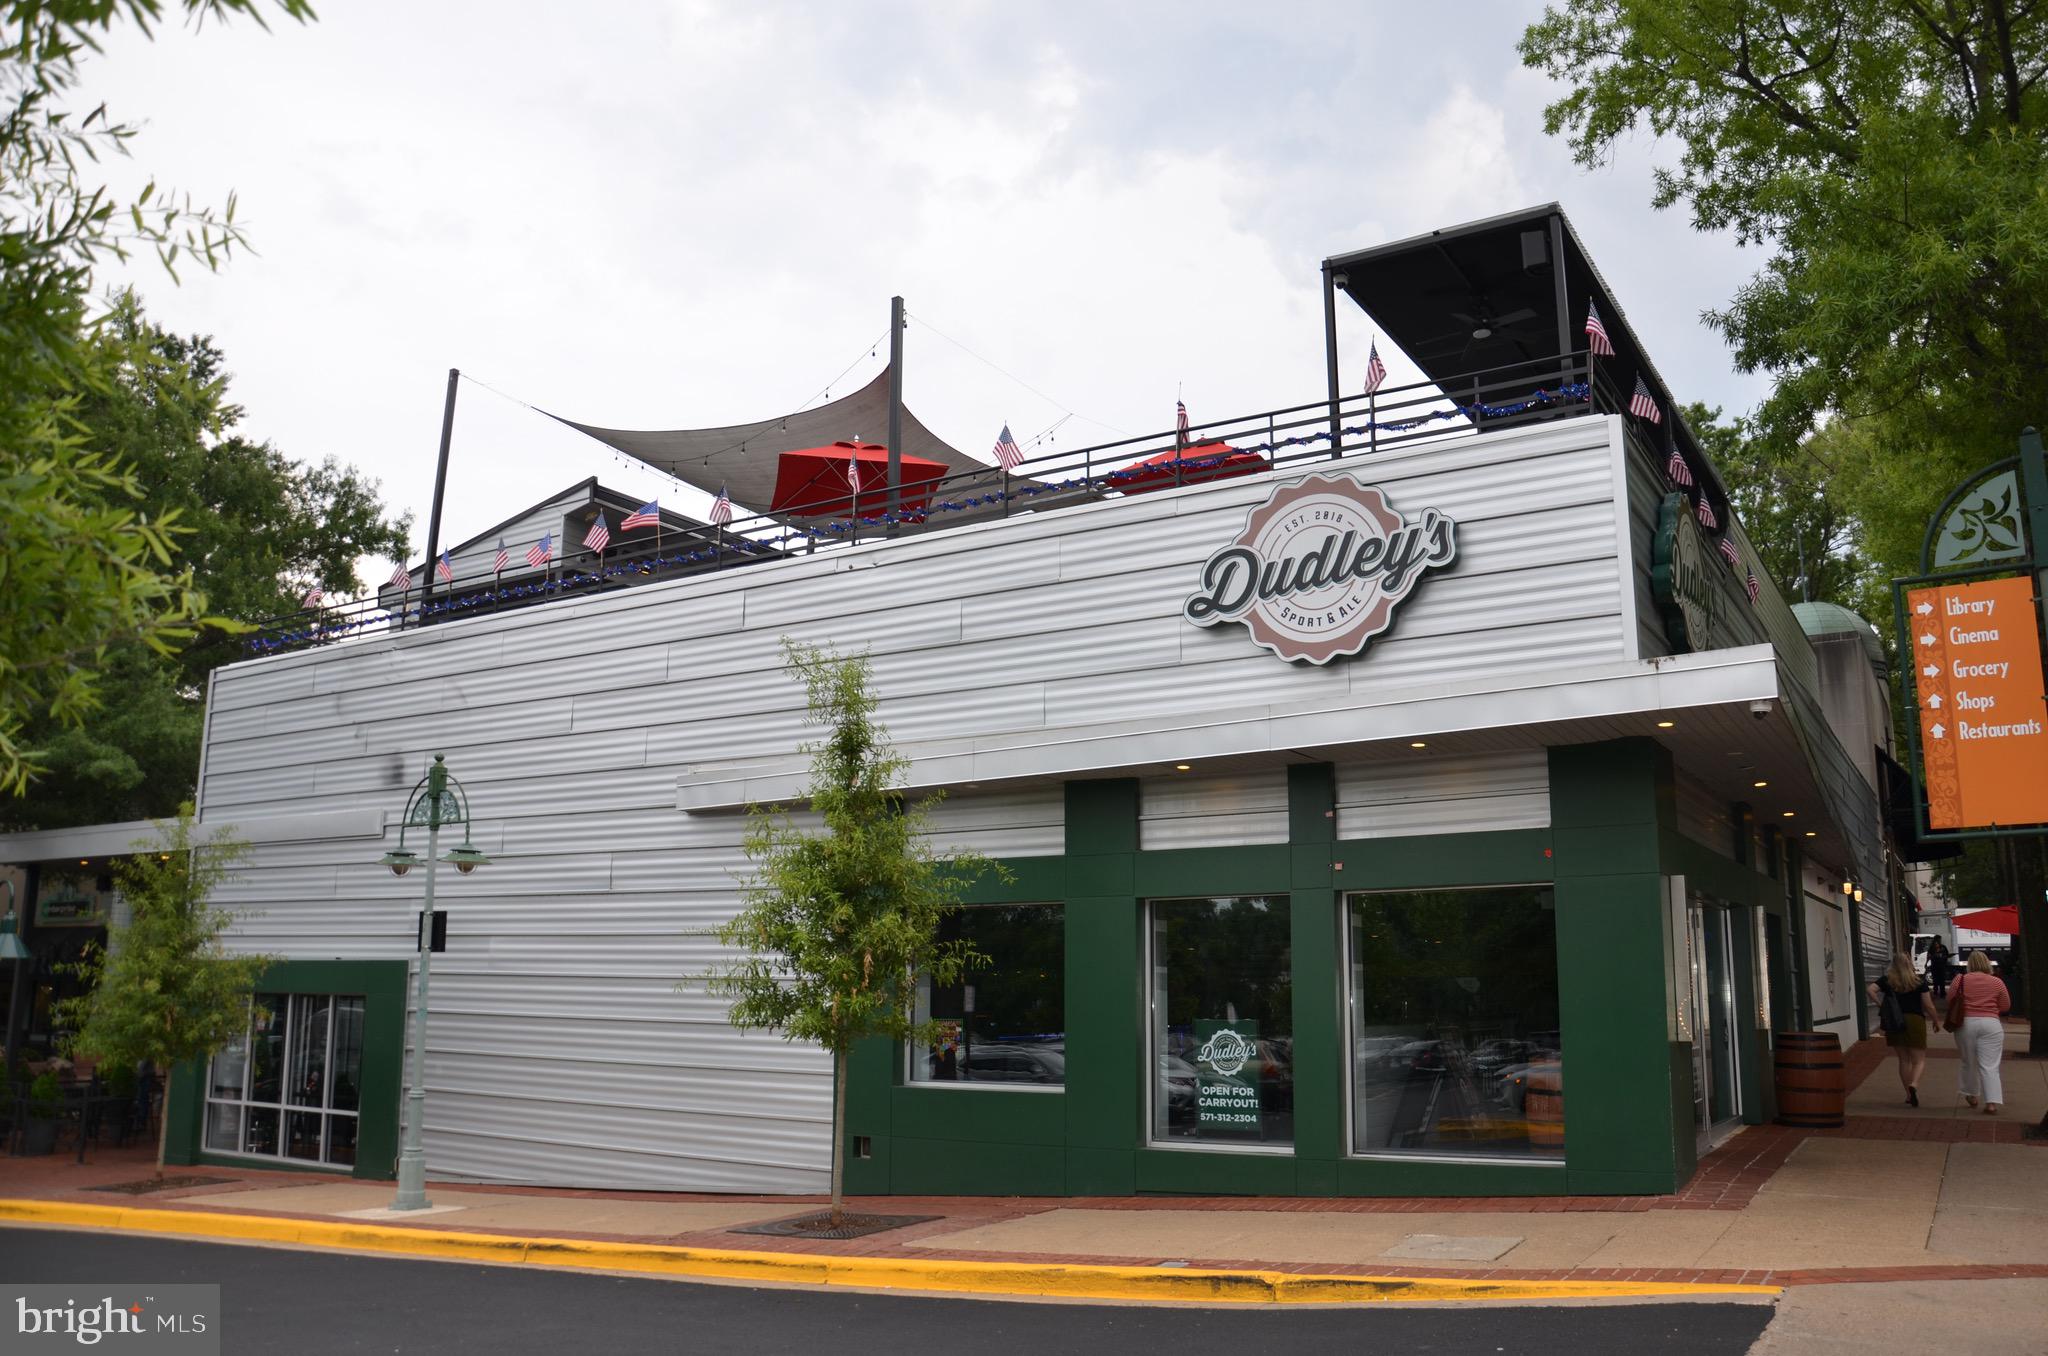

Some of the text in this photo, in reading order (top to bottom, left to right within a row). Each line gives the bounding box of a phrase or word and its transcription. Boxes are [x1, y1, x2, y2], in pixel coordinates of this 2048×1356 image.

[1284, 514, 1310, 532] EST.
[1187, 512, 1450, 619] Dudley's
[1281, 595, 1362, 627] SPORT & ALE
[1946, 597, 1995, 616] Library
[1949, 627, 1999, 645] Cinema
[1952, 660, 2009, 678] Grocery
[1956, 691, 1995, 712] Shops
[1959, 719, 2041, 740] Restaurants
[1197, 1042, 1256, 1062] Dudley's
[1202, 1086, 1254, 1096] OPEN FOR
[1199, 1098, 1258, 1108] CARRYOUT!
[1200, 1113, 1257, 1122] 571-312-2304
